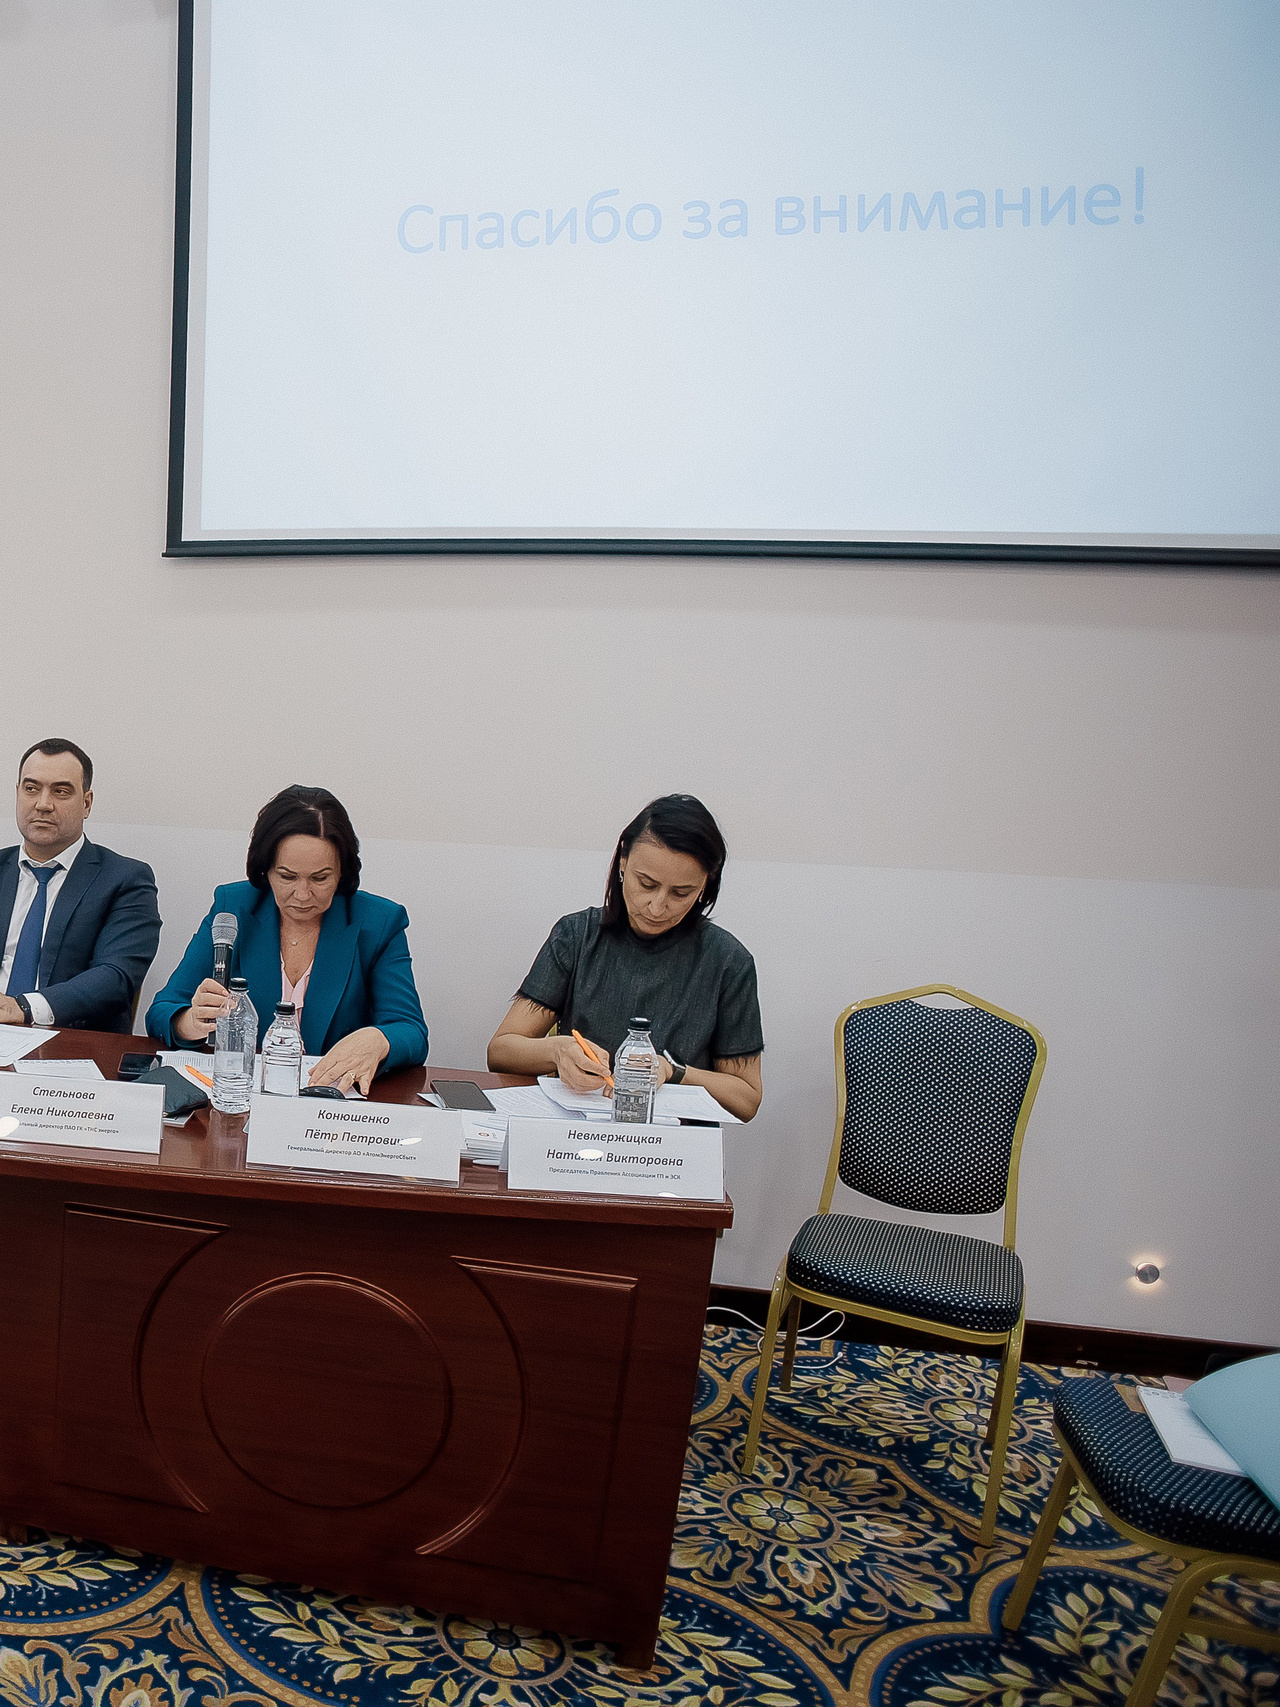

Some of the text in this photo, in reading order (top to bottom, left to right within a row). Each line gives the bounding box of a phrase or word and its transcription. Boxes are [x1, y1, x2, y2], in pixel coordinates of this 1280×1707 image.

[397, 167, 1146, 255] Спасибо за внимание!
[32, 1086, 95, 1100] Стельнова
[11, 1103, 115, 1121] Елена Николаевна
[317, 1109, 390, 1125] Конюшенко
[304, 1128, 338, 1143] Пётр
[567, 1129, 663, 1146] Невмержицкая
[287, 1144, 324, 1153] Генеральный
[325, 1148, 352, 1156] директор
[546, 1148, 684, 1168] Ната Викторовна
[549, 1166, 589, 1175] Председатель
[590, 1168, 621, 1177] Правления
[621, 1171, 656, 1179] Ассоциации
